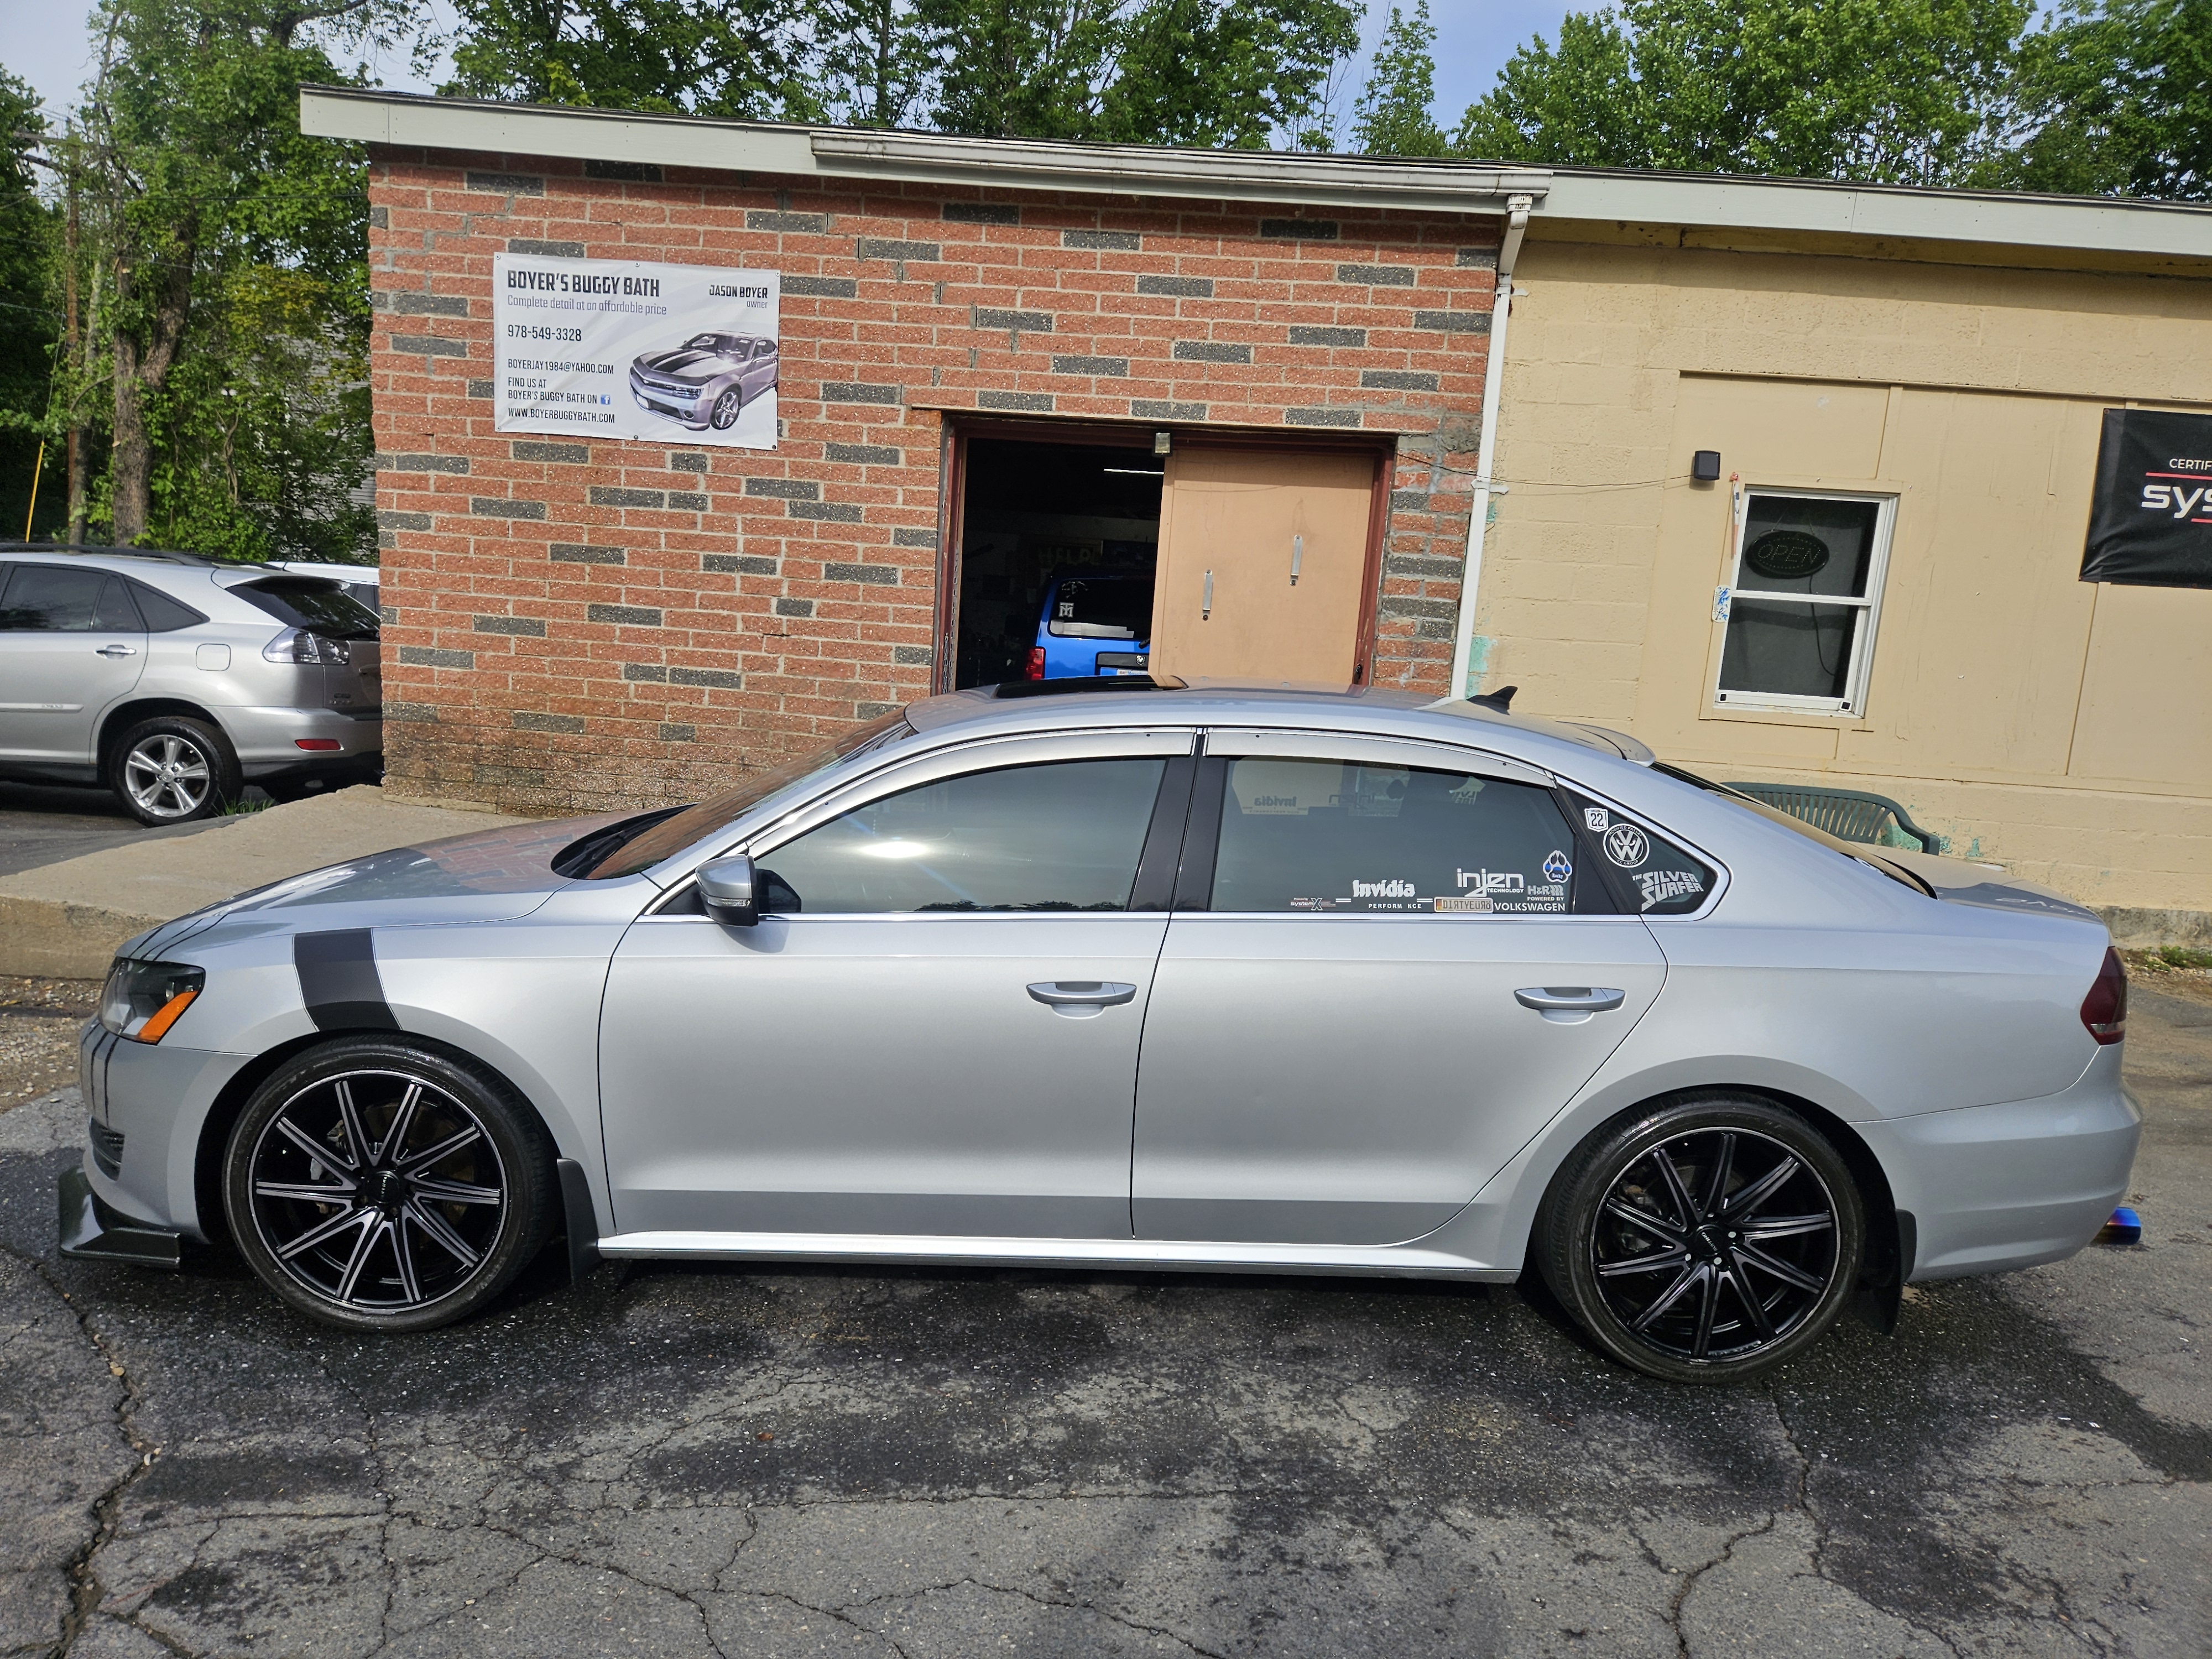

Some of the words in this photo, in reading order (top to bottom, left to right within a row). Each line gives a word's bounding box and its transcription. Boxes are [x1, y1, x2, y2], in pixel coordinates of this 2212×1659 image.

[508, 270, 568, 291] BOYER'S
[572, 274, 620, 295] BUGGY
[624, 277, 660, 297] BATH
[709, 285, 737, 297] JASON
[739, 286, 768, 299] BOYER
[508, 295, 548, 308] Complete
[551, 297, 574, 310] detail
[576, 300, 585, 310] at
[587, 302, 597, 311] an
[599, 300, 643, 314] affordable
[645, 303, 666, 316] price
[747, 300, 768, 309] owner
[508, 324, 582, 342] 978-549-3328
[508, 377, 525, 387] FIND
[527, 378, 536, 388] US
[538, 379, 547, 388] AT
[508, 389, 538, 400] BOYER'S
[540, 392, 564, 401] BUGGY
[567, 393, 585, 403] BATH
[587, 394, 597, 404] ON
[508, 408, 615, 424] WWW.BOYERBUGGYBATH.COM
[1757, 542, 1822, 565] OPEN
[1590, 813, 1604, 827] 22
[1352, 879, 1416, 898] Invidia
[1457, 868, 1524, 897] injen
[1641, 871, 1698, 889] SILVER
[1527, 885, 1551, 896] H&R
[1641, 882, 1704, 912] SURFER
[1494, 902, 1566, 911] VOLKSWAGEN
